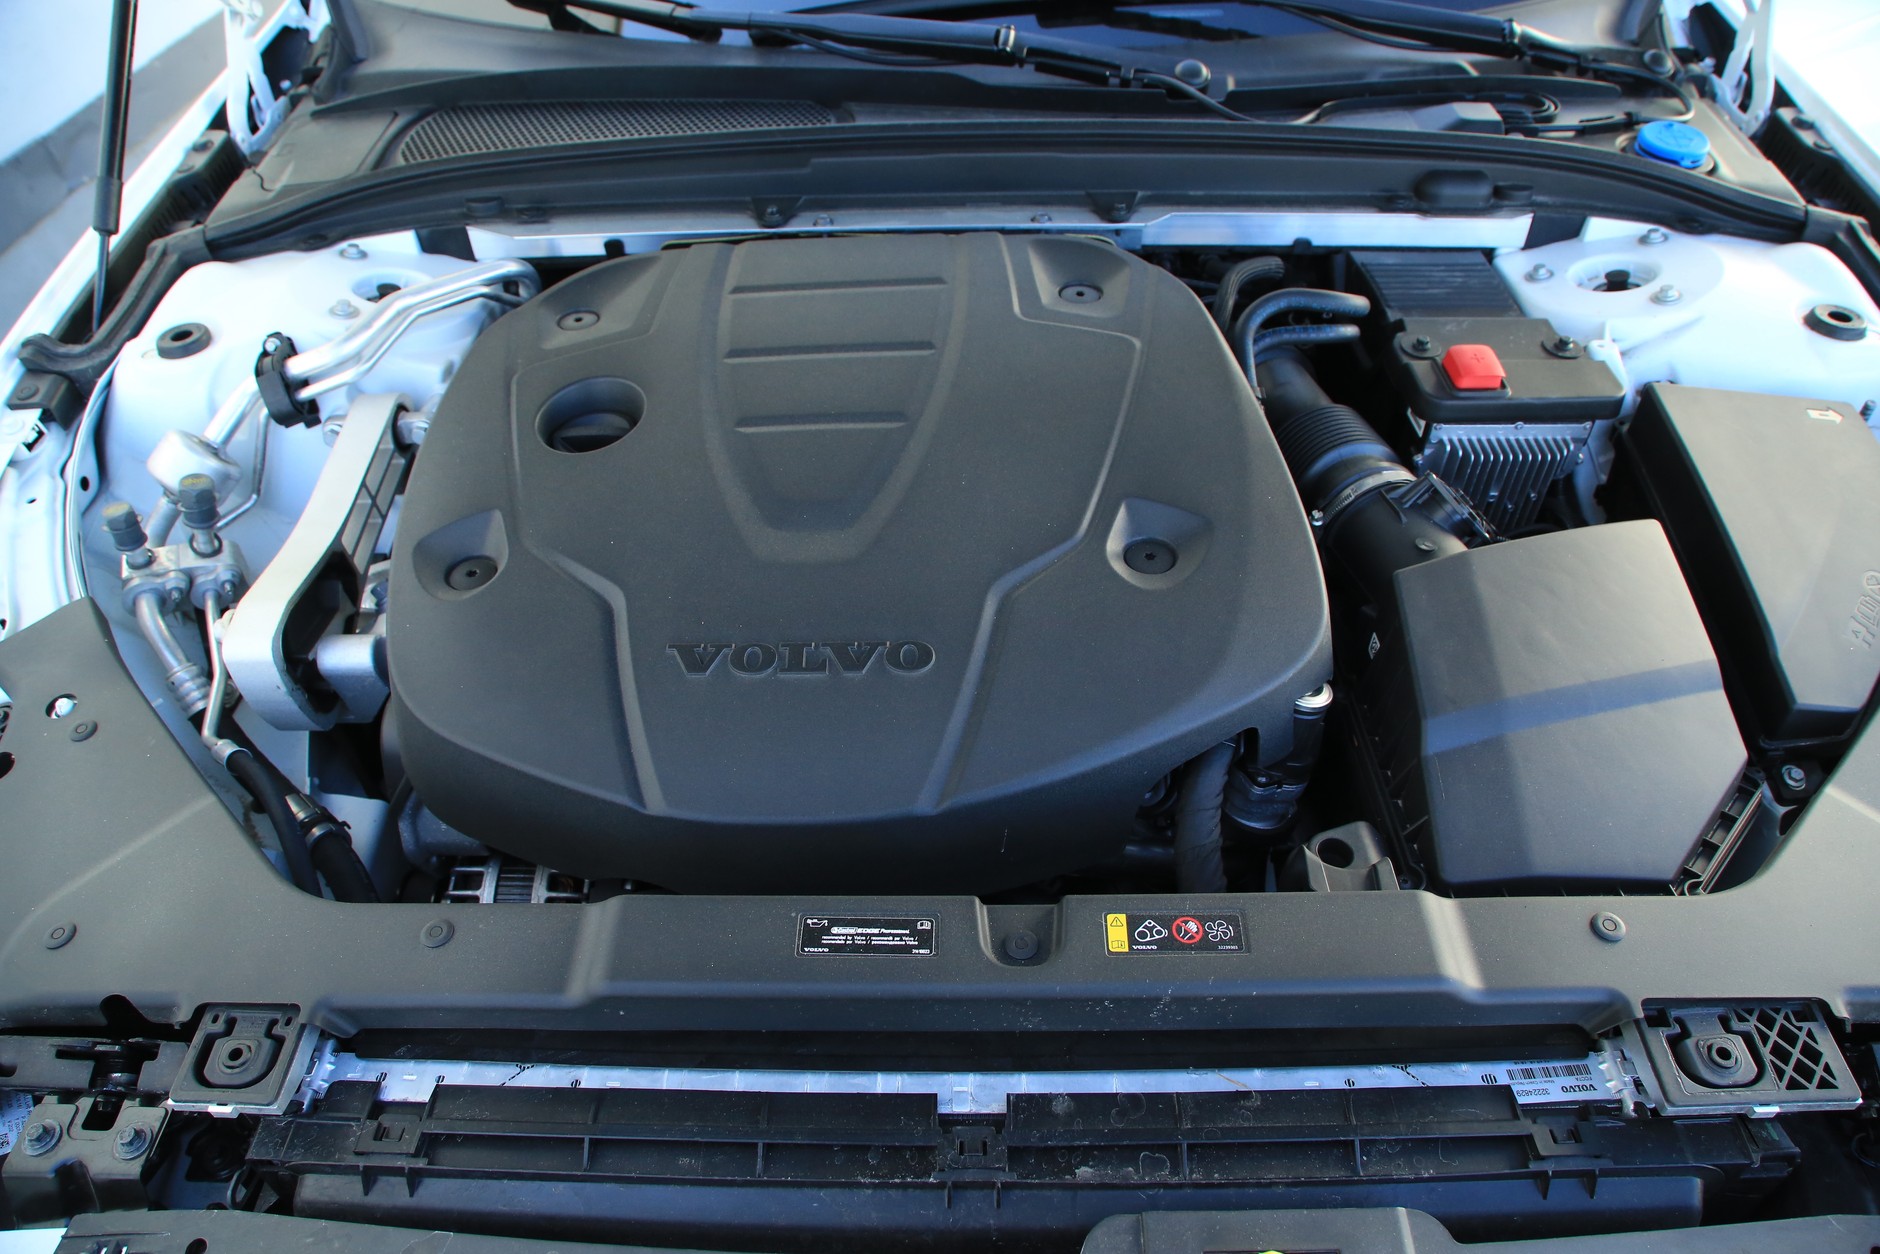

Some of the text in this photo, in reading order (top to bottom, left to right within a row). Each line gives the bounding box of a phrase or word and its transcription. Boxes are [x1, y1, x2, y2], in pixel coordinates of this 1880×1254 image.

[666, 640, 936, 677] VOLVO
[1516, 1088, 1550, 1096] 32224829
[1561, 1084, 1598, 1093] VOLVO
